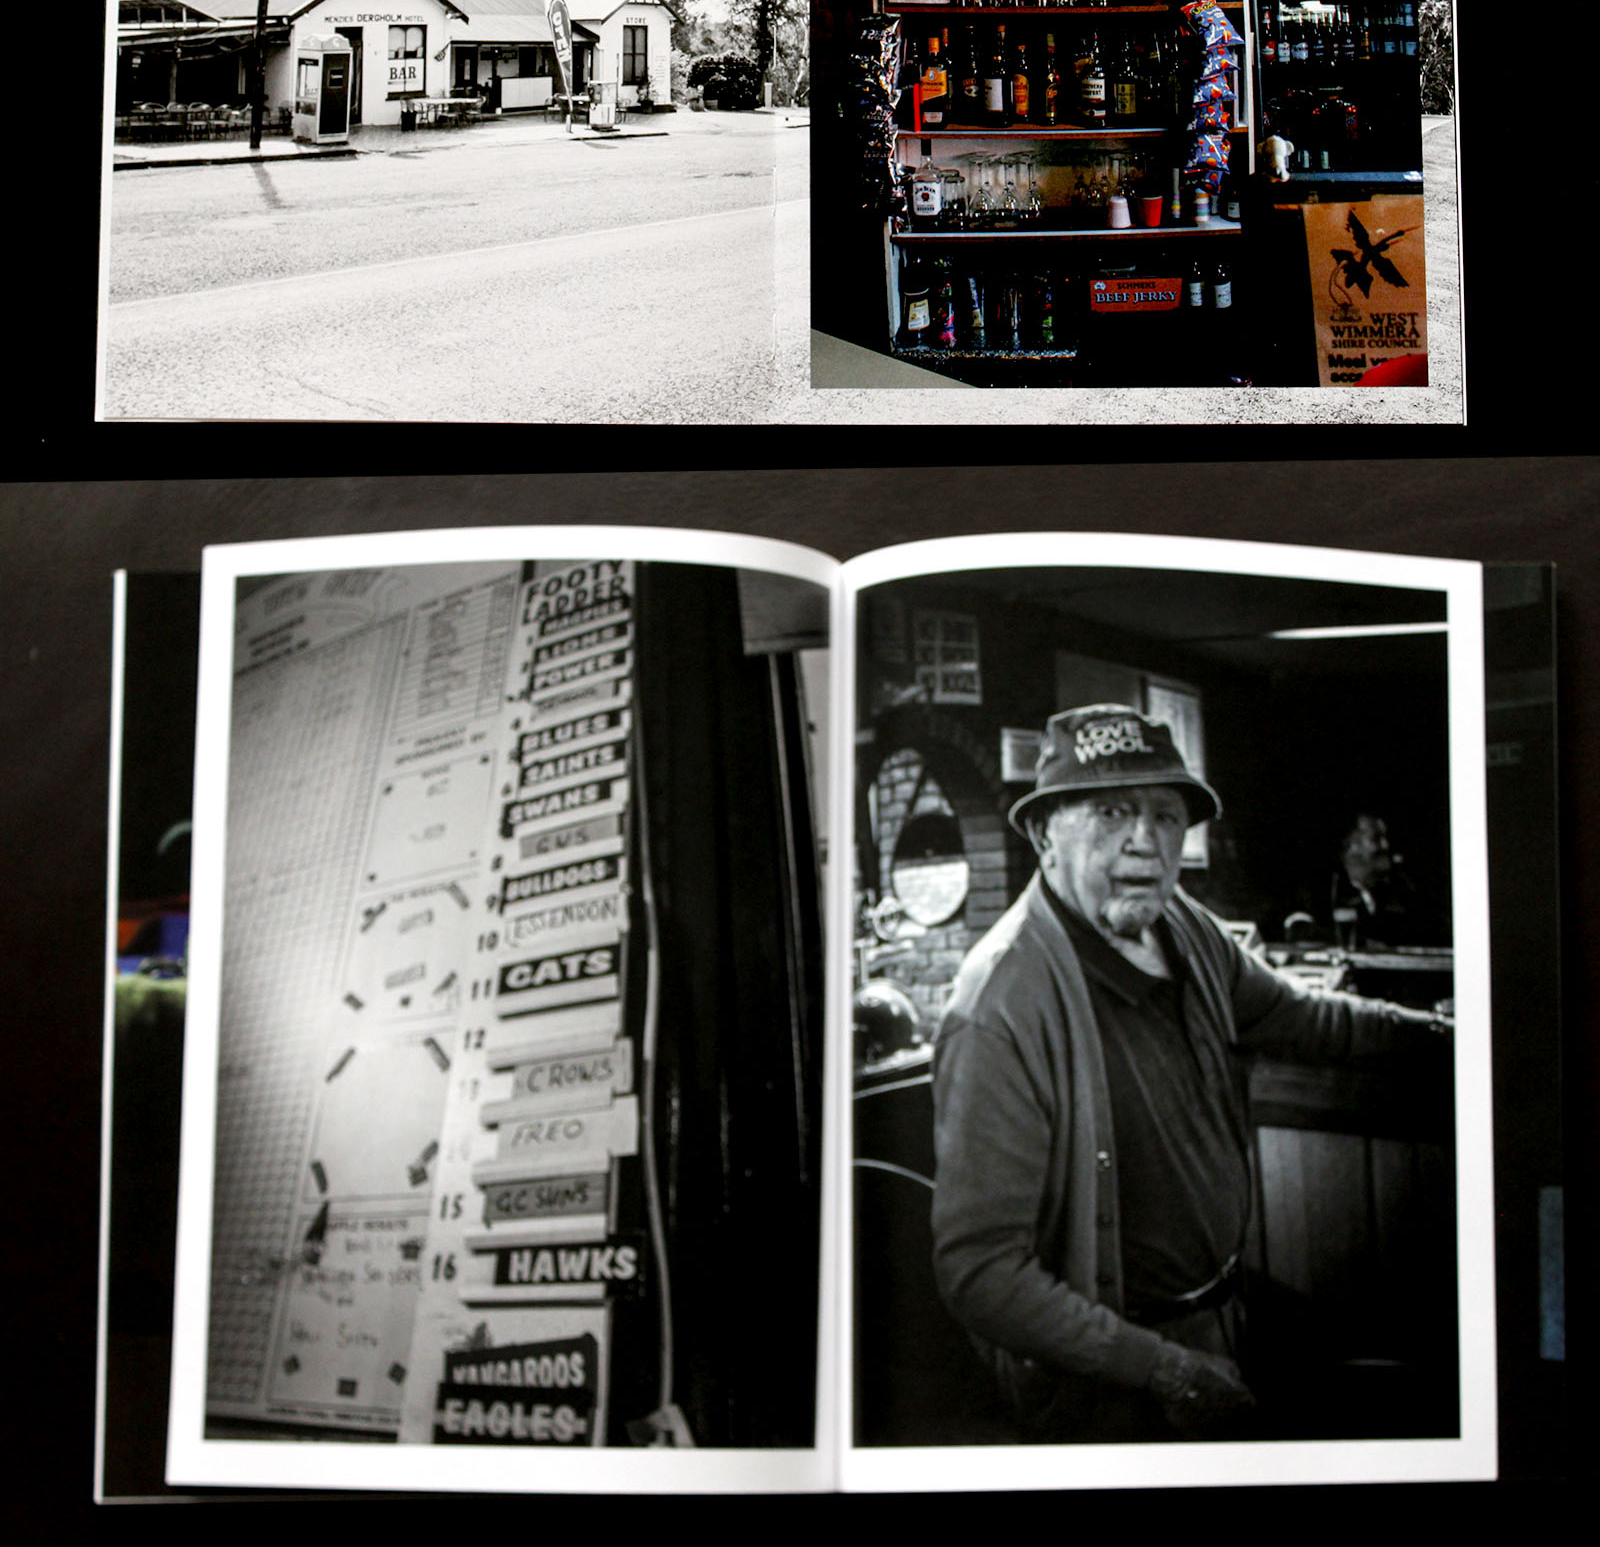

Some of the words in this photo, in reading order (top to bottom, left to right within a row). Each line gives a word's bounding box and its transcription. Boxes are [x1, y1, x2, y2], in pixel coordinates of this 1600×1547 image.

[356, 14, 402, 23] DERGHOLM
[389, 66, 417, 80] BAR
[1096, 292, 1131, 303] BEEF
[1133, 291, 1177, 304] JERKY
[1330, 324, 1421, 339] WIMMERA
[1370, 313, 1419, 326] WEST
[1331, 339, 1366, 348] SHIRE
[1367, 338, 1421, 348] COUNCIL
[1328, 353, 1367, 368] Meal
[526, 559, 624, 603] FOOTY
[522, 575, 625, 625] LADDER
[533, 653, 614, 690] POWER
[522, 713, 610, 753] BLUES
[1076, 720, 1141, 745] LOVE
[524, 744, 615, 786] SAINTS
[1073, 736, 1155, 765] WOOL
[508, 783, 600, 824] SWANS
[505, 858, 608, 902] BULLDOGS
[477, 932, 499, 952] 10
[472, 979, 492, 1000] 11
[505, 949, 613, 989] CATS
[526, 1058, 614, 1093] CROWS
[510, 1118, 585, 1149] FREO
[439, 1193, 463, 1221] 15
[496, 1189, 529, 1213] GC
[432, 1252, 457, 1282] 16
[508, 1245, 638, 1283] HAWKS
[440, 1398, 578, 1443] EAGLES
